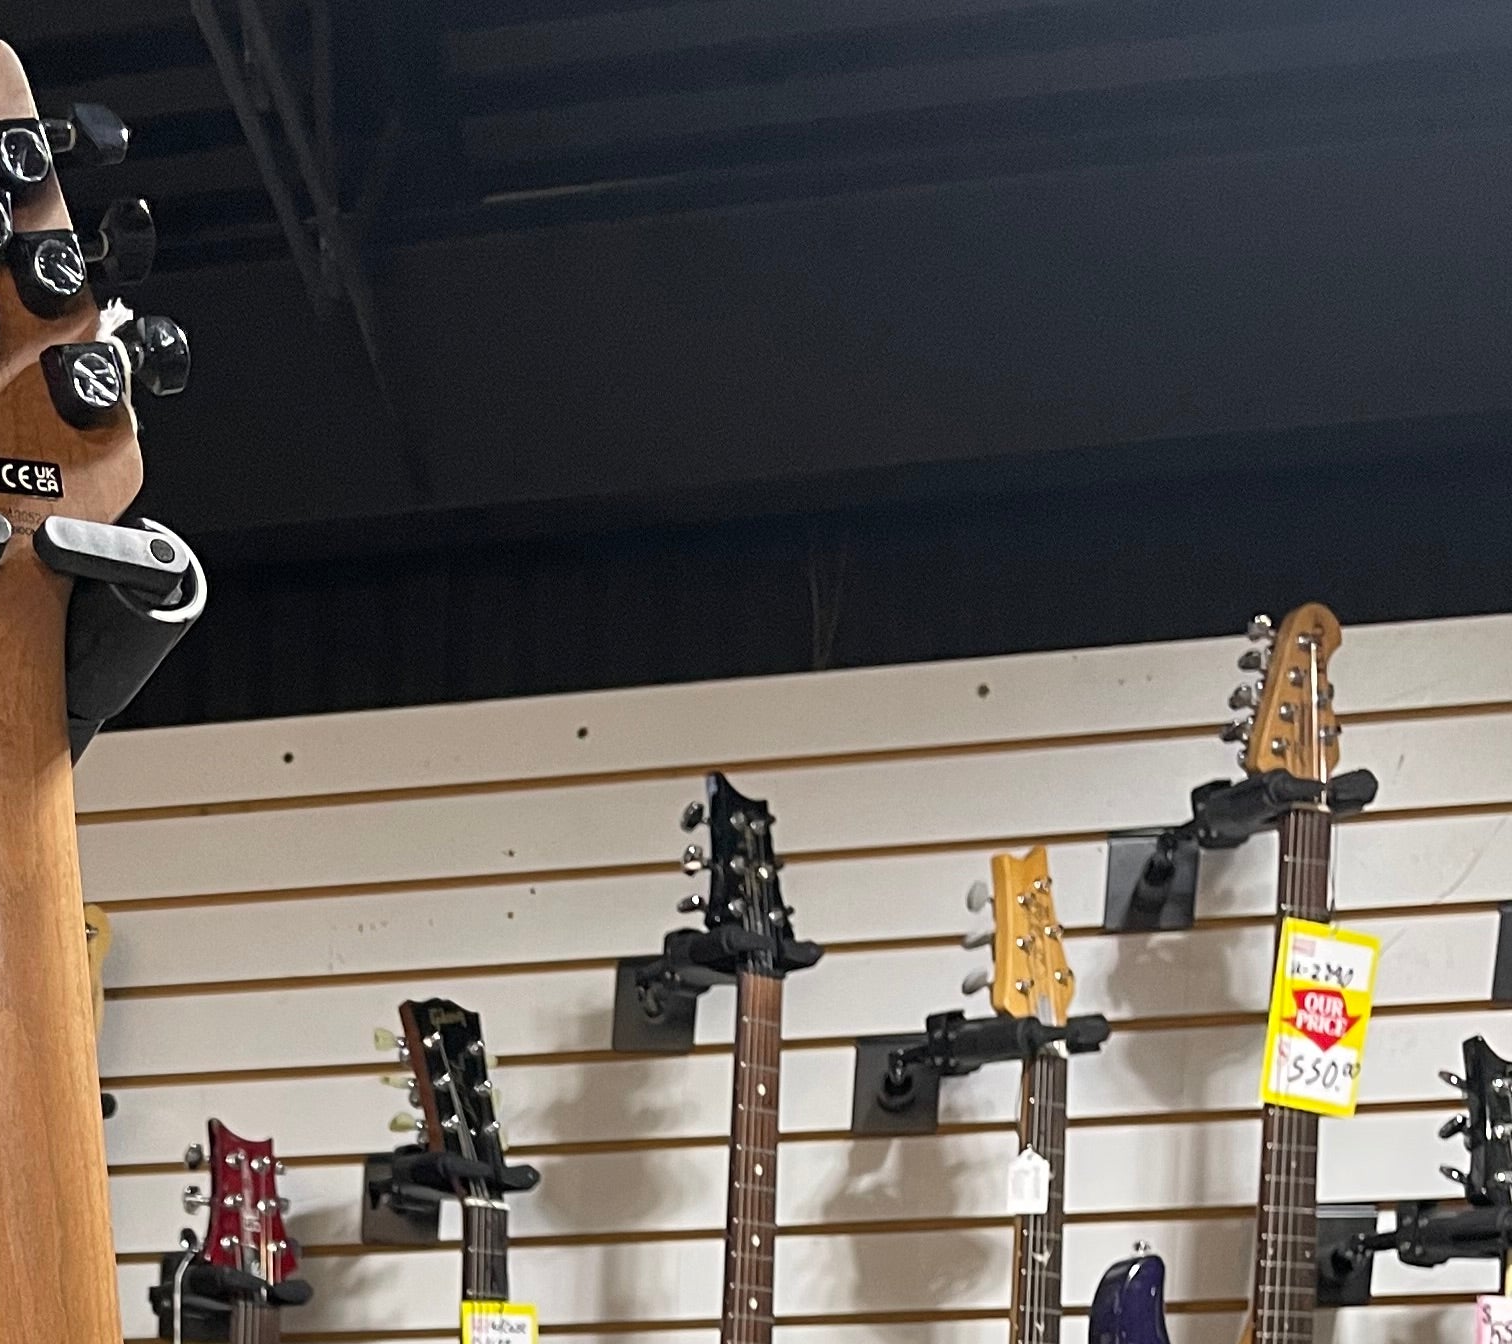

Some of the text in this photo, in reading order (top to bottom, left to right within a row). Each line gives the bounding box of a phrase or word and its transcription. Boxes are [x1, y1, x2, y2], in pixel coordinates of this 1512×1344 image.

[34, 466, 56, 480] UK
[36, 479, 60, 493] CA
[1303, 991, 1345, 1016] OUR
[1295, 1008, 1350, 1038] PRICE
